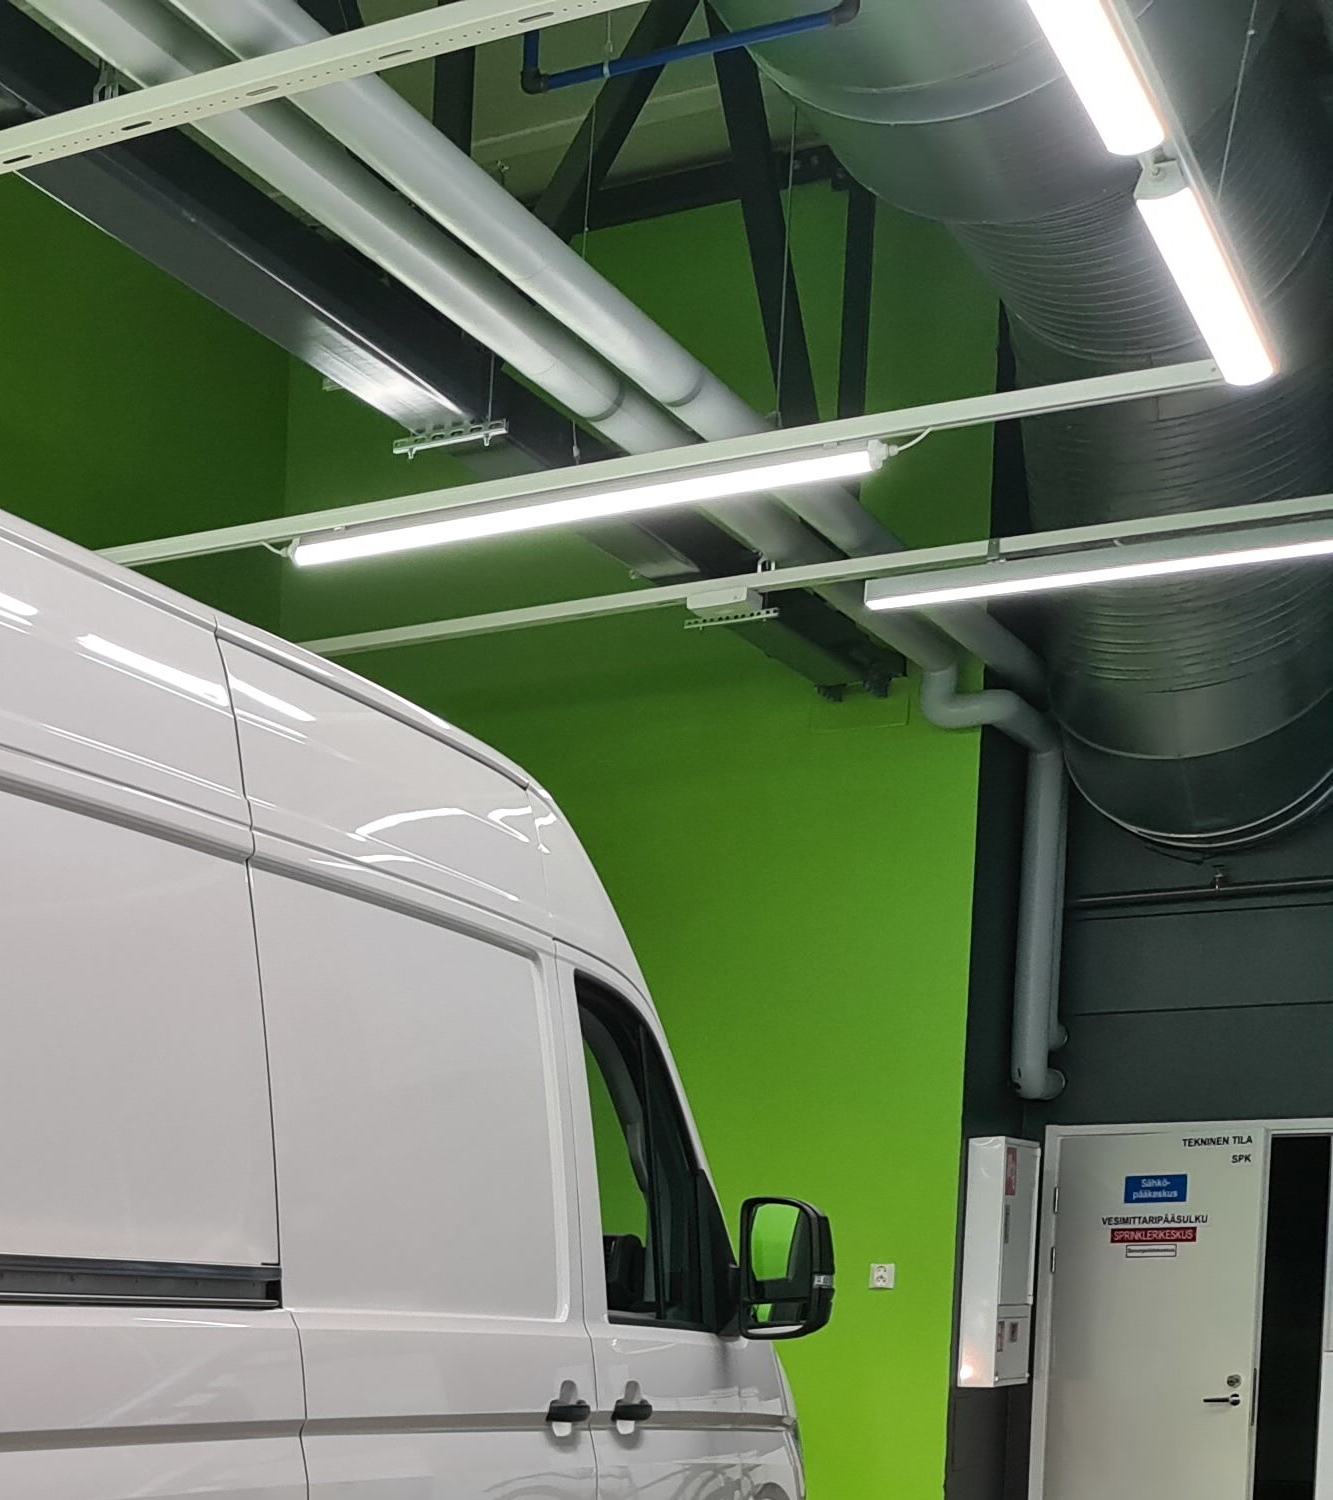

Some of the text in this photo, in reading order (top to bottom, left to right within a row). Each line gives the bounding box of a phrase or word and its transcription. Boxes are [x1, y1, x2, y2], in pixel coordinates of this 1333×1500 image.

[1182, 1135, 1253, 1147] TEKNINEN TILA
[1231, 1154, 1252, 1163] SPK
[1141, 1178, 1171, 1188] Sähkö-
[1132, 1189, 1178, 1199] pääkeskus
[1101, 1213, 1209, 1226] VESIMITTARIPÄÄSULKU
[1113, 1229, 1194, 1241] SPRINKLERIKESKUS
